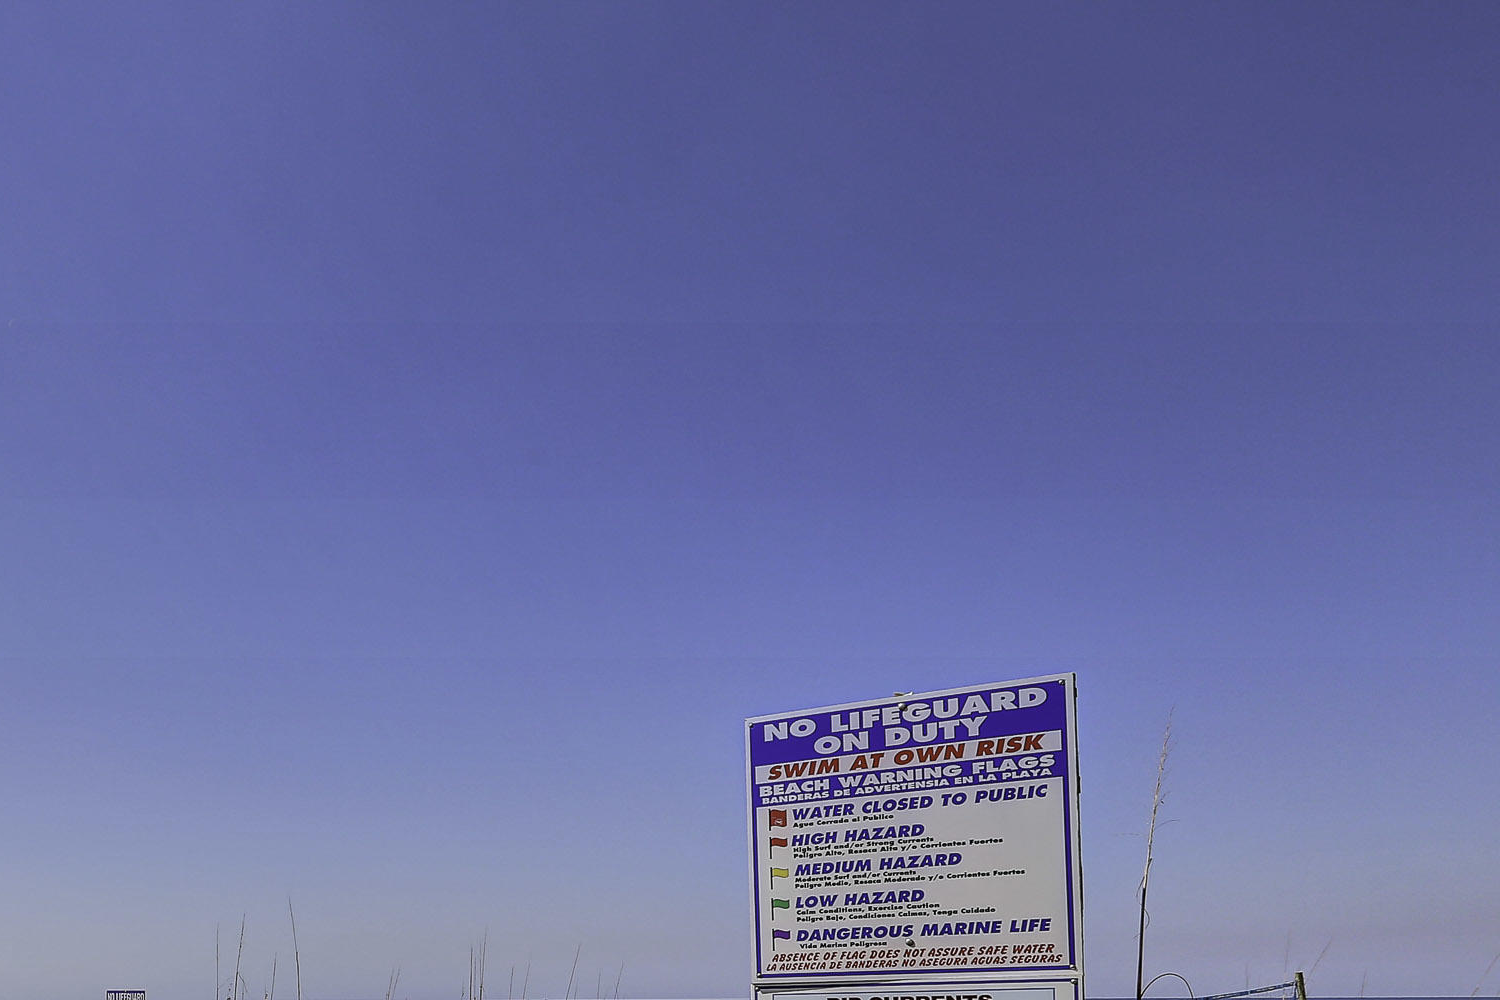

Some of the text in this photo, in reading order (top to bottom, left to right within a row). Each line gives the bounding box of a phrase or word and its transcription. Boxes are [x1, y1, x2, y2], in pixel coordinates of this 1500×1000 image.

[764, 687, 1047, 742] NO LIFEGUARD
[814, 716, 988, 754] ON DUTY
[768, 733, 1046, 780] SWIM AT OWN RISK
[759, 754, 1056, 798] BEACH WARNING FLAGS
[762, 768, 1052, 805] BANDERAS DE ADVERTENSIA EN LA PLAYA
[792, 784, 1048, 820] WATER CLOSED TO PUBLIC
[863, 814, 894, 822] Publico
[792, 824, 925, 847] HIGH HAZARD
[834, 842, 864, 850] and/or
[900, 844, 918, 852] y/o
[920, 840, 966, 849] Corrientes
[969, 838, 1004, 846] Fuertes
[794, 852, 962, 876] MEDIUM HAZARD
[928, 874, 944, 882] y/o
[946, 870, 990, 879] Corrientes
[796, 890, 925, 910] LOW HAZARD
[818, 906, 865, 914] Conditions,
[868, 904, 903, 912] Exercise
[796, 915, 824, 924] Peligro
[848, 912, 896, 920] Condiciones
[796, 918, 1052, 942] DANGEROUS MARINE LIFE
[766, 954, 1063, 972] LA AUSENCIA DE BANDERAS NO ASEGURA AGUAS SEGURAS
[772, 944, 1055, 962] ABSENCE OF FLAG DOES NOT ASSURE SAFE WATER
